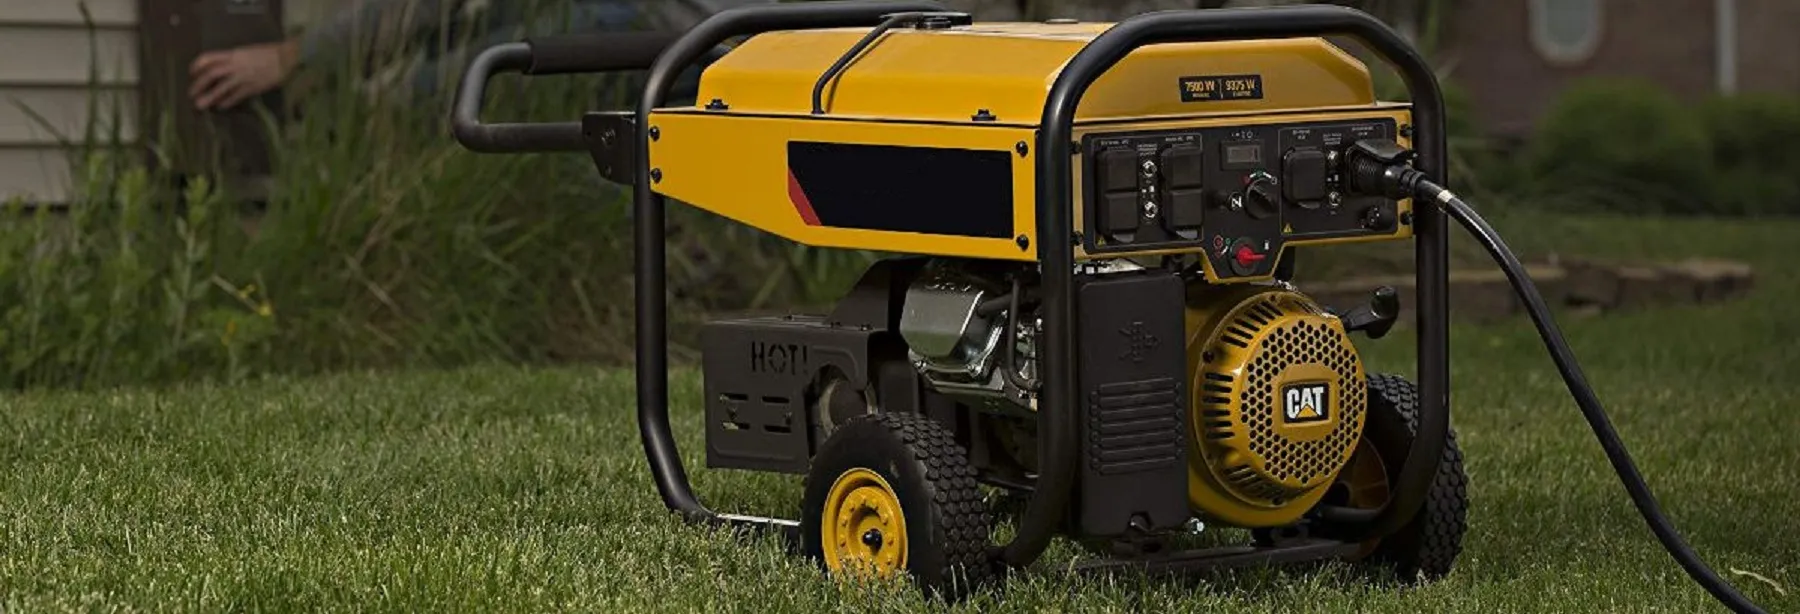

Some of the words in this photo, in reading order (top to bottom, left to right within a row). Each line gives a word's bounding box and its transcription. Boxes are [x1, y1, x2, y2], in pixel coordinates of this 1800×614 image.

[1185, 81, 1204, 92] 7500
[1204, 80, 1215, 91] W
[1225, 80, 1245, 91] 9375
[1245, 79, 1255, 89] W
[751, 341, 808, 376] HOT!
[1286, 386, 1324, 418] CAT
